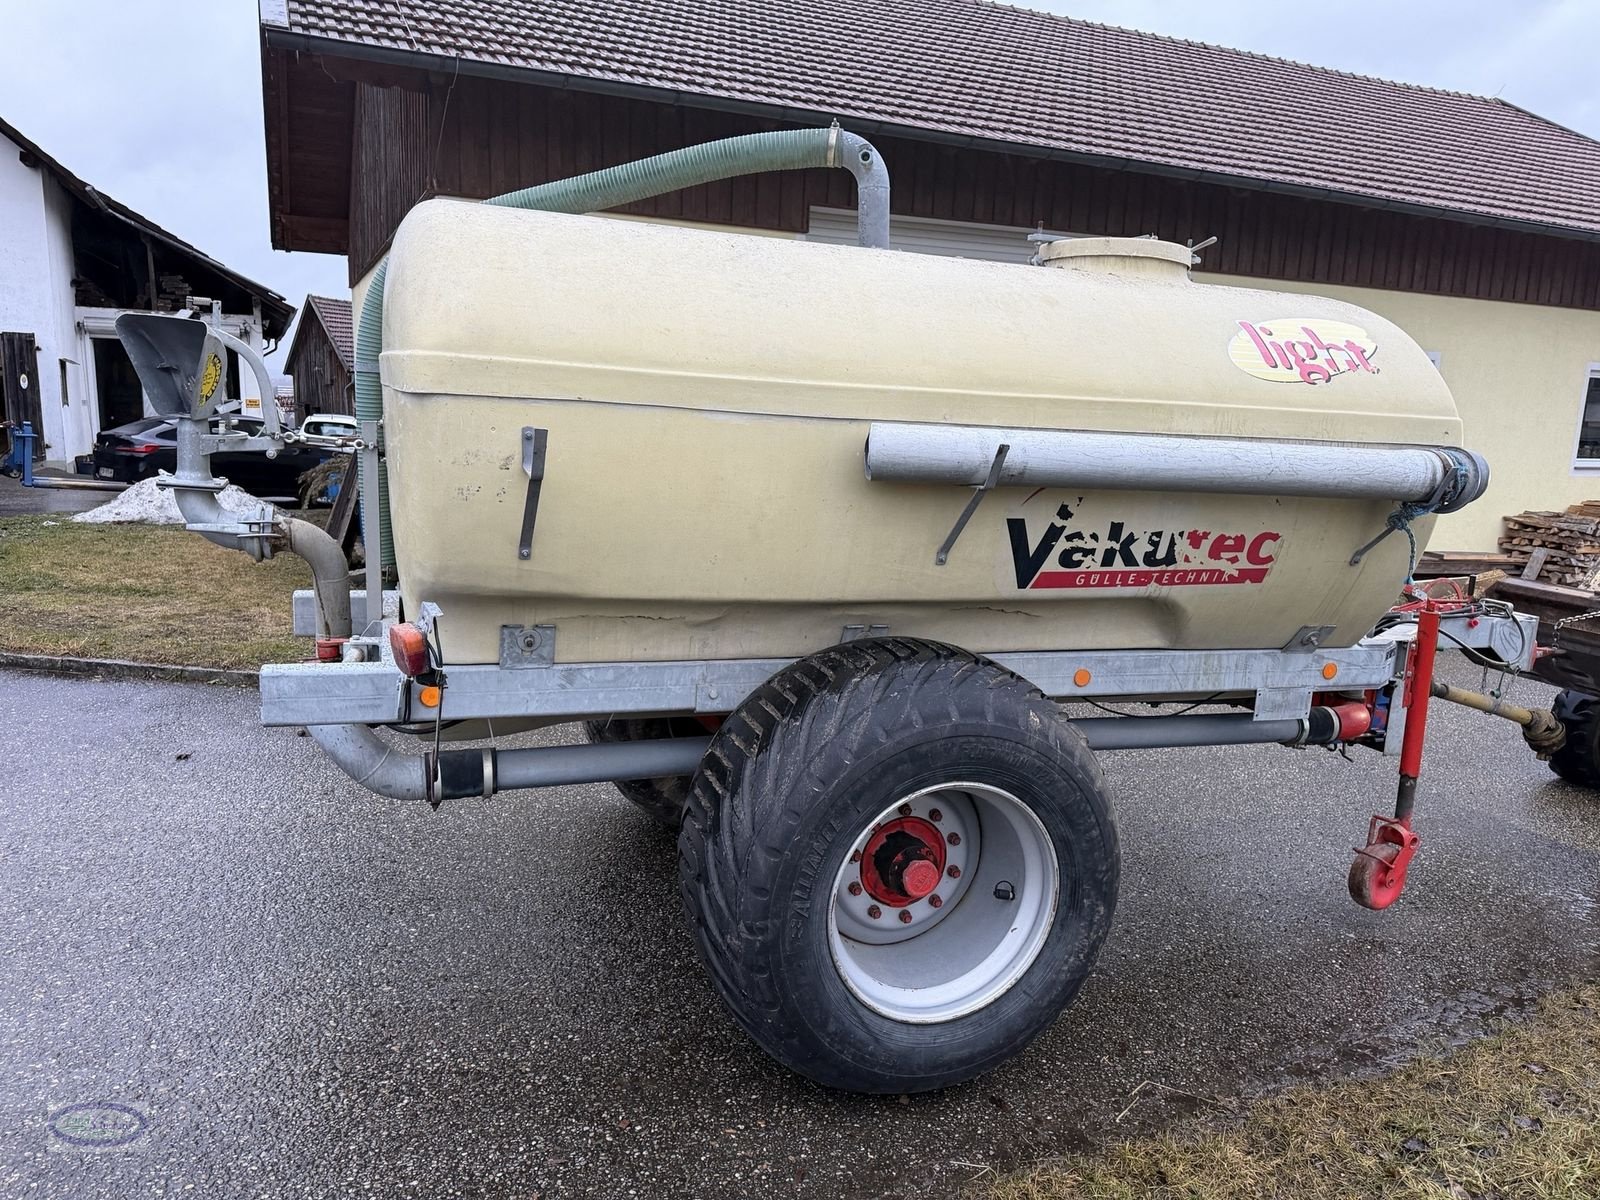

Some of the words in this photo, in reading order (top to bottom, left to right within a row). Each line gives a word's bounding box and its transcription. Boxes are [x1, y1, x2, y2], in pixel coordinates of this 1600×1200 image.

[1237, 320, 1380, 385] light
[1075, 572, 1230, 586] GÜLLE-TECHNIK
[793, 818, 843, 918] ALLIANCE
